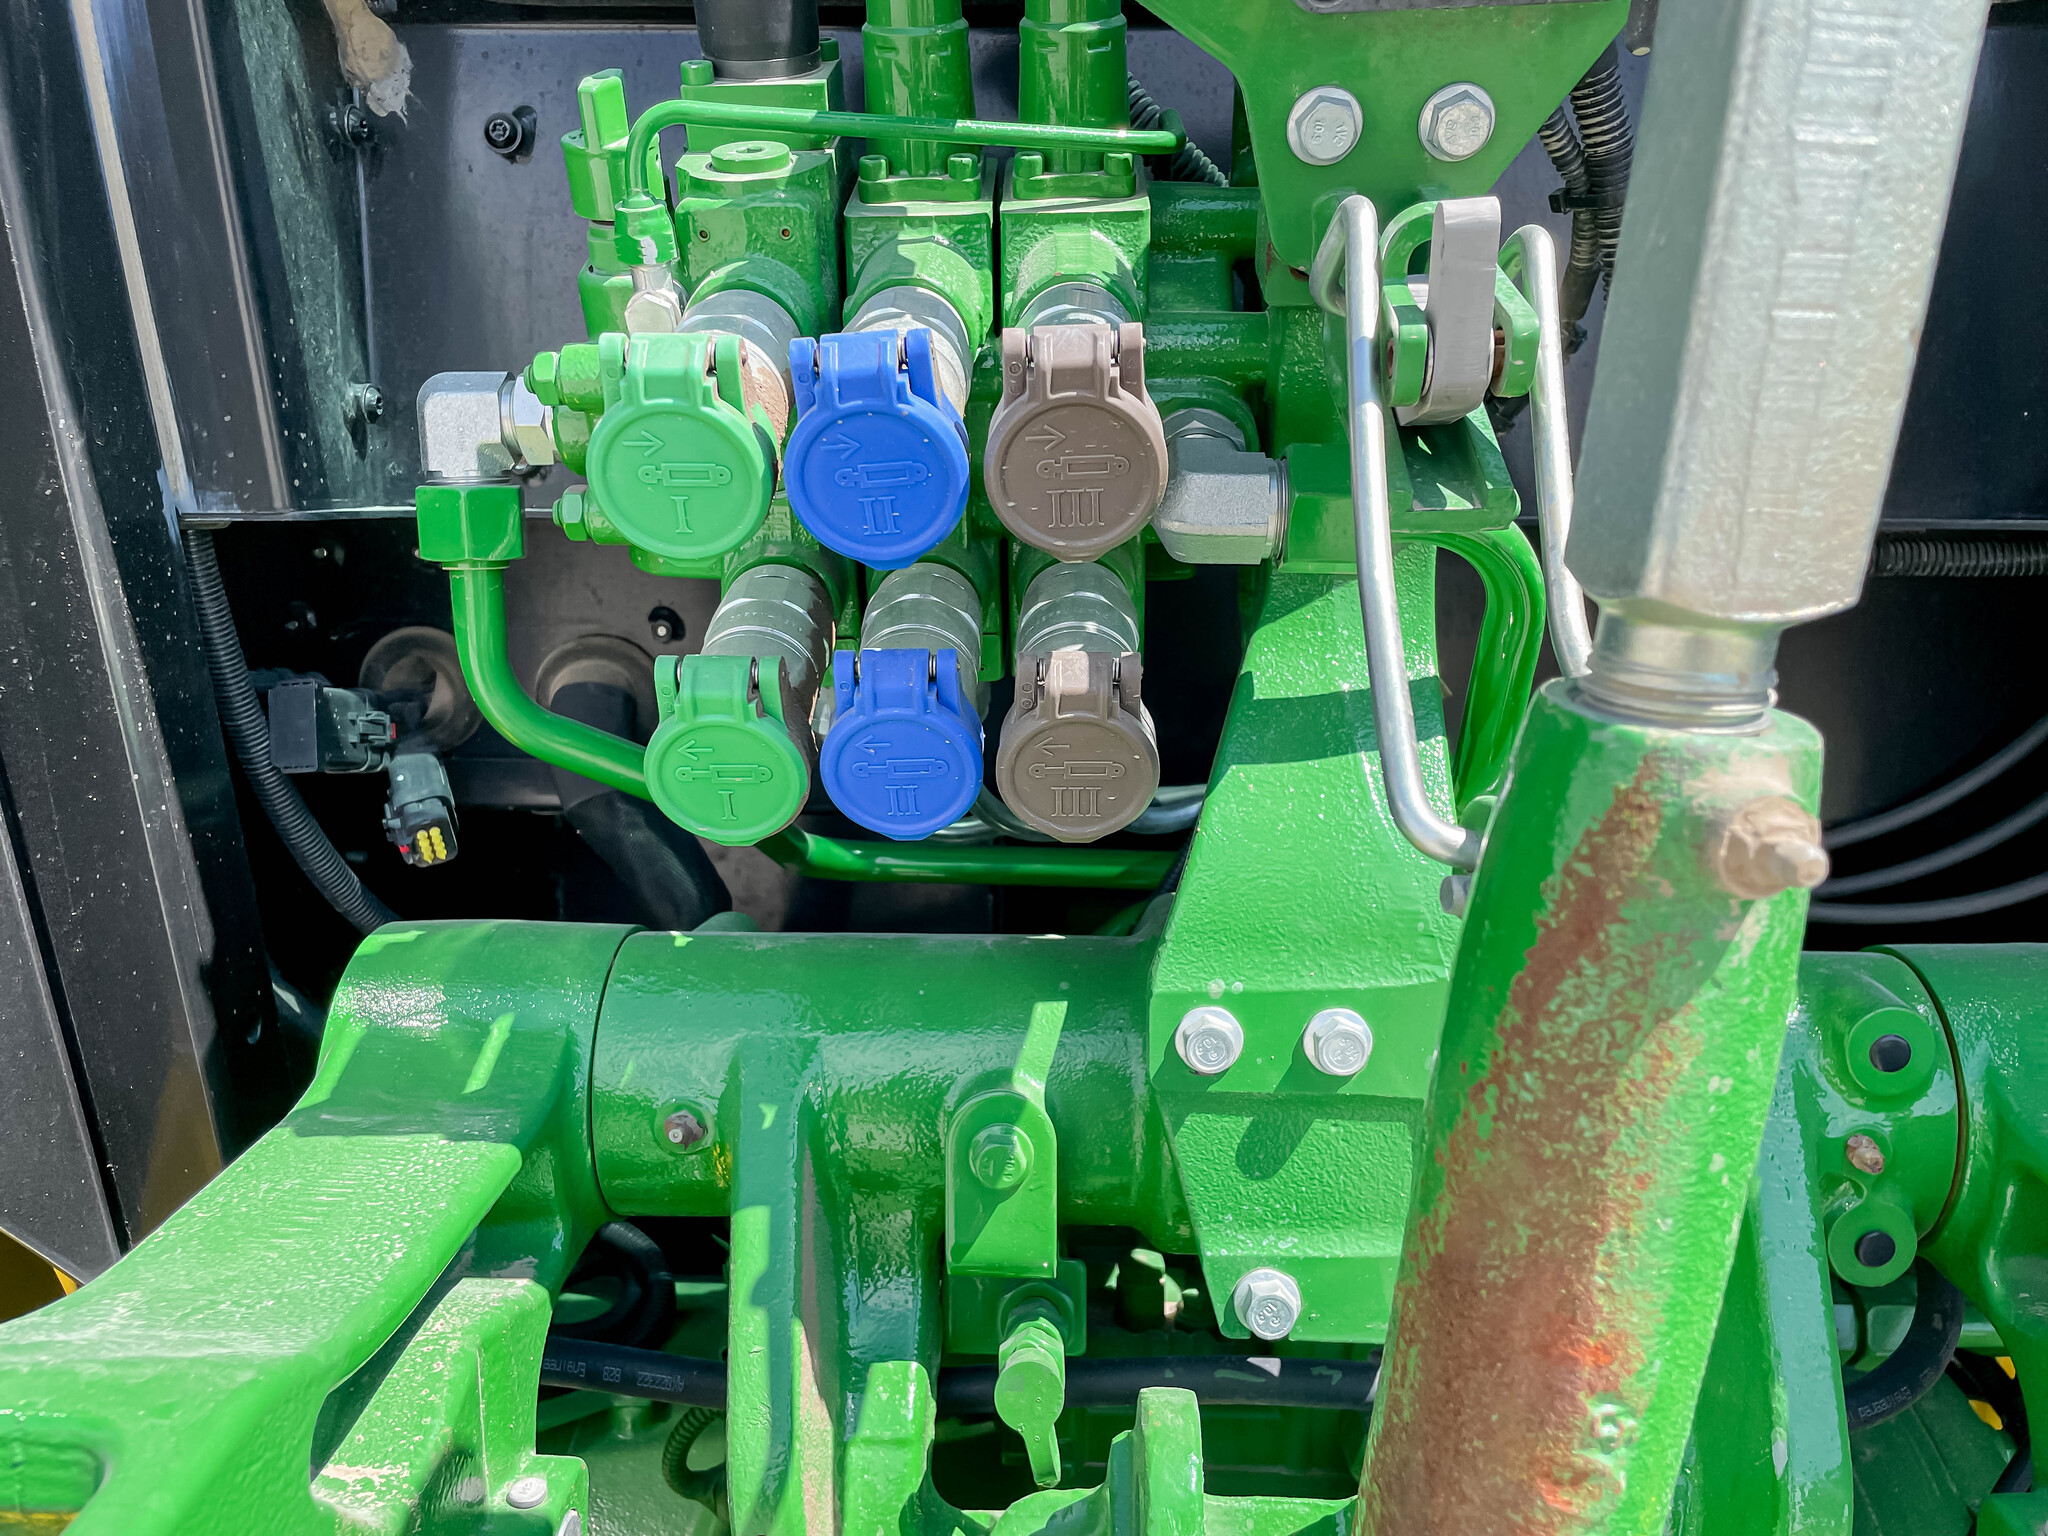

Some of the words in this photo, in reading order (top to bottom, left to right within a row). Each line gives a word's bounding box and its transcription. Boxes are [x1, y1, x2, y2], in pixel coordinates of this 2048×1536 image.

[670, 496, 693, 534] I
[858, 495, 900, 536] II
[1046, 488, 1105, 528] III
[718, 790, 738, 821] I
[885, 784, 921, 816] II
[1051, 786, 1102, 817] III
